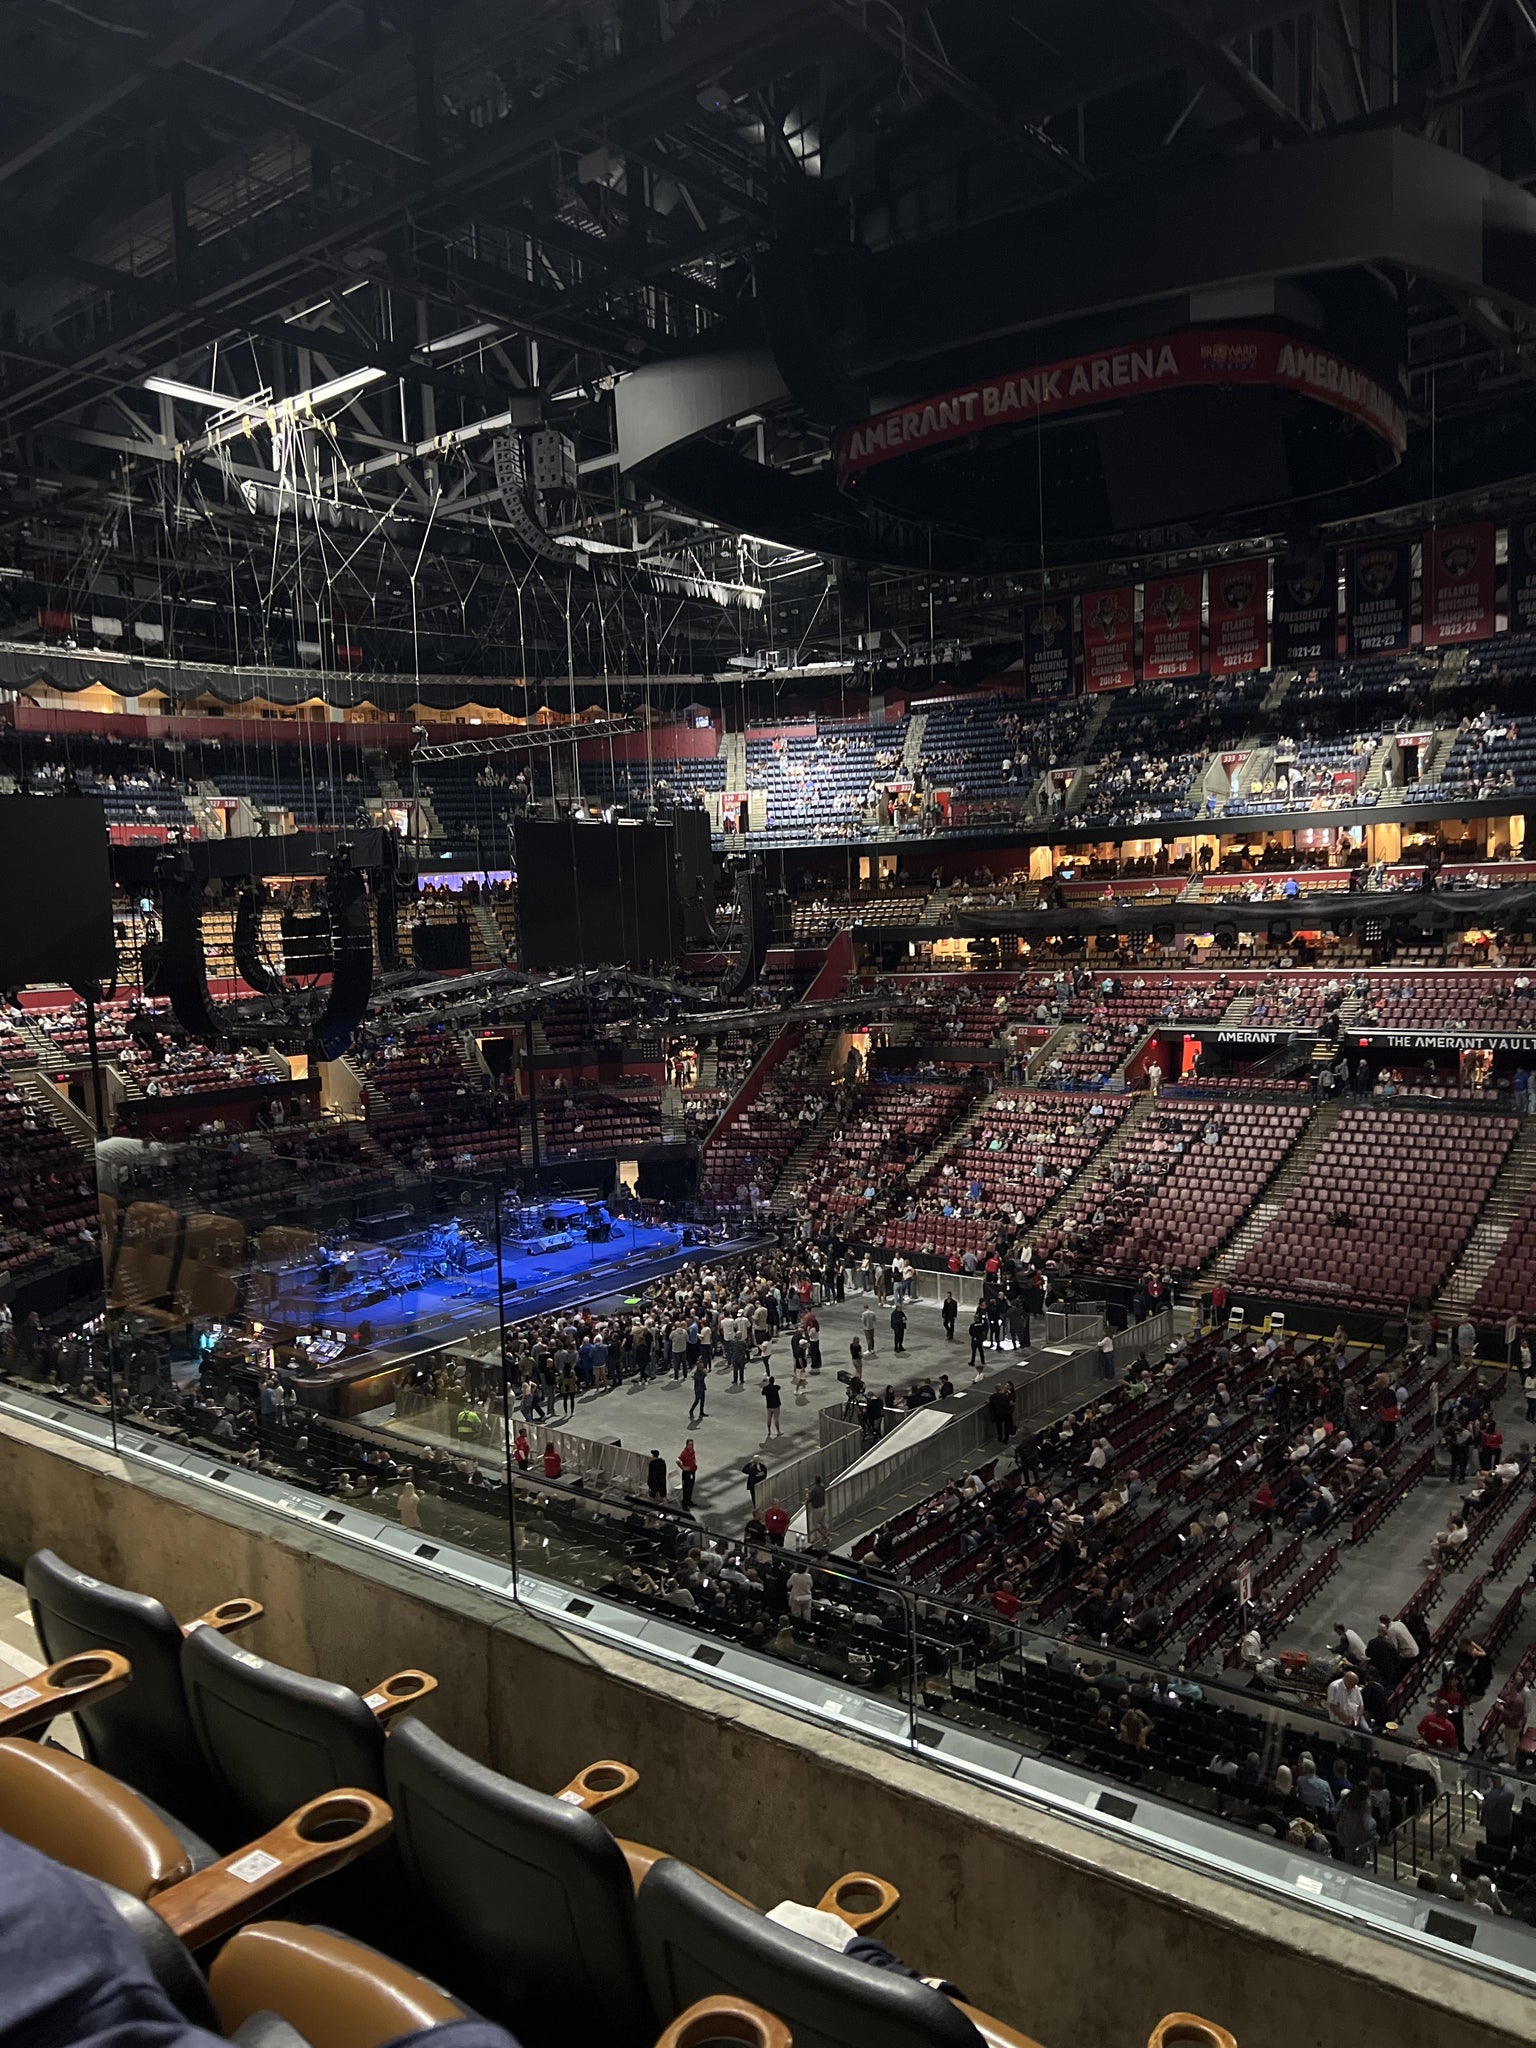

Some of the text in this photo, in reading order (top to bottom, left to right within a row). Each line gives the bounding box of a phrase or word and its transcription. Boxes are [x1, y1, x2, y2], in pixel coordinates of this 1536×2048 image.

[849, 344, 1179, 460] AMERANT BANK ARENA
[1438, 582, 1480, 599] ATLANTIC
[1360, 598, 1396, 613] EASTERN
[1438, 596, 1478, 611] DIVISION
[1222, 617, 1255, 632] ATLANTIC
[1352, 609, 1404, 626] CONFERENCE
[1432, 608, 1484, 626] CHAMPIONS
[1288, 621, 1320, 634] TROPHY
[1354, 622, 1402, 638] CHAMPIONS
[1440, 621, 1476, 636] 2023-24
[1154, 631, 1190, 644] ATLANTIC
[1222, 629, 1254, 644] DIVISION
[1361, 634, 1395, 649] 2022-23
[1034, 648, 1062, 662] EASTERN
[1156, 642, 1188, 654] DIVISION
[1216, 639, 1259, 656] CHAMPIONS
[1288, 645, 1321, 658] 2021-22
[1150, 650, 1194, 664] CHAMPIONS
[1224, 652, 1253, 666] 2021-22
[1030, 658, 1068, 673] CONFERENCE
[1158, 662, 1187, 674] 2015-16
[1030, 669, 1068, 684] CHAMPIONS
[1100, 674, 1122, 686] 2011-12
[1217, 1032, 1277, 1043] AMERANT
[1387, 1036, 1411, 1047] THE
[1414, 1037, 1484, 1048] AMERANT
